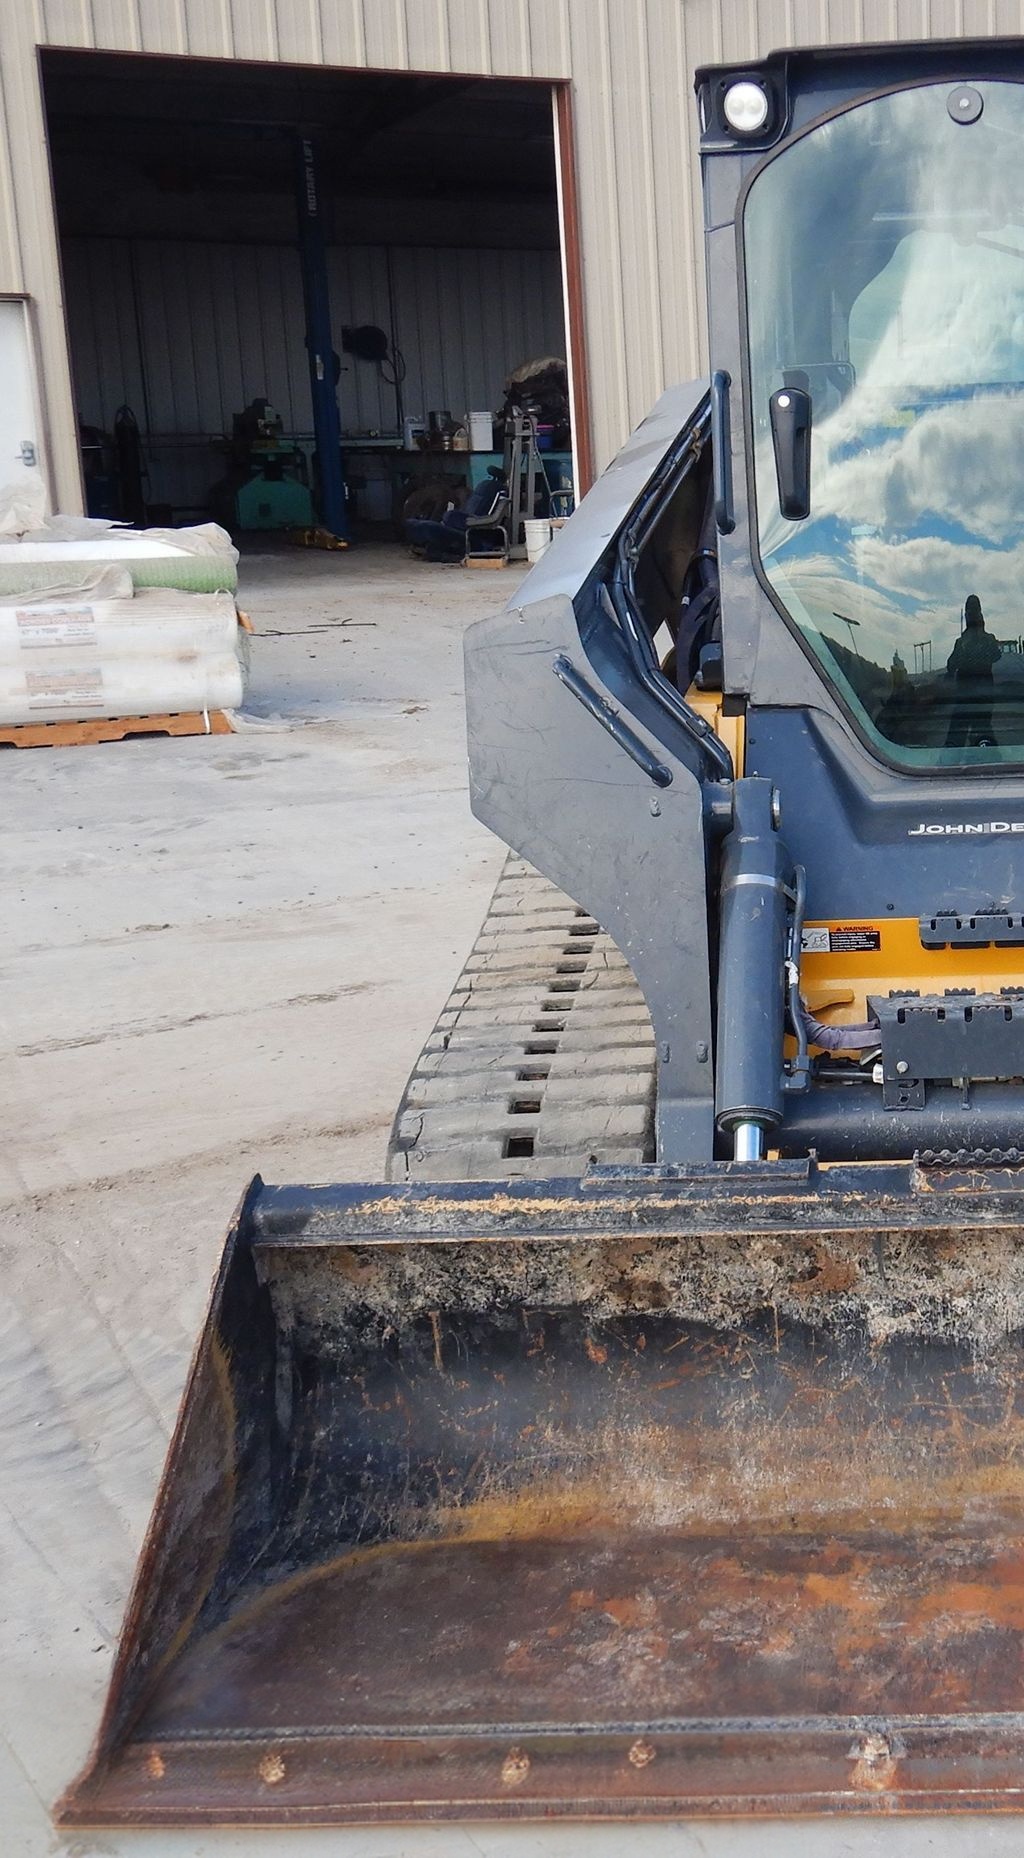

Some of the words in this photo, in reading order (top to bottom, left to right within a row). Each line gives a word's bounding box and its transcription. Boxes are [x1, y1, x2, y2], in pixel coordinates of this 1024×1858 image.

[302, 139, 314, 163] LIFT
[304, 165, 317, 210] ROTARY
[909, 823, 982, 835] JOHN
